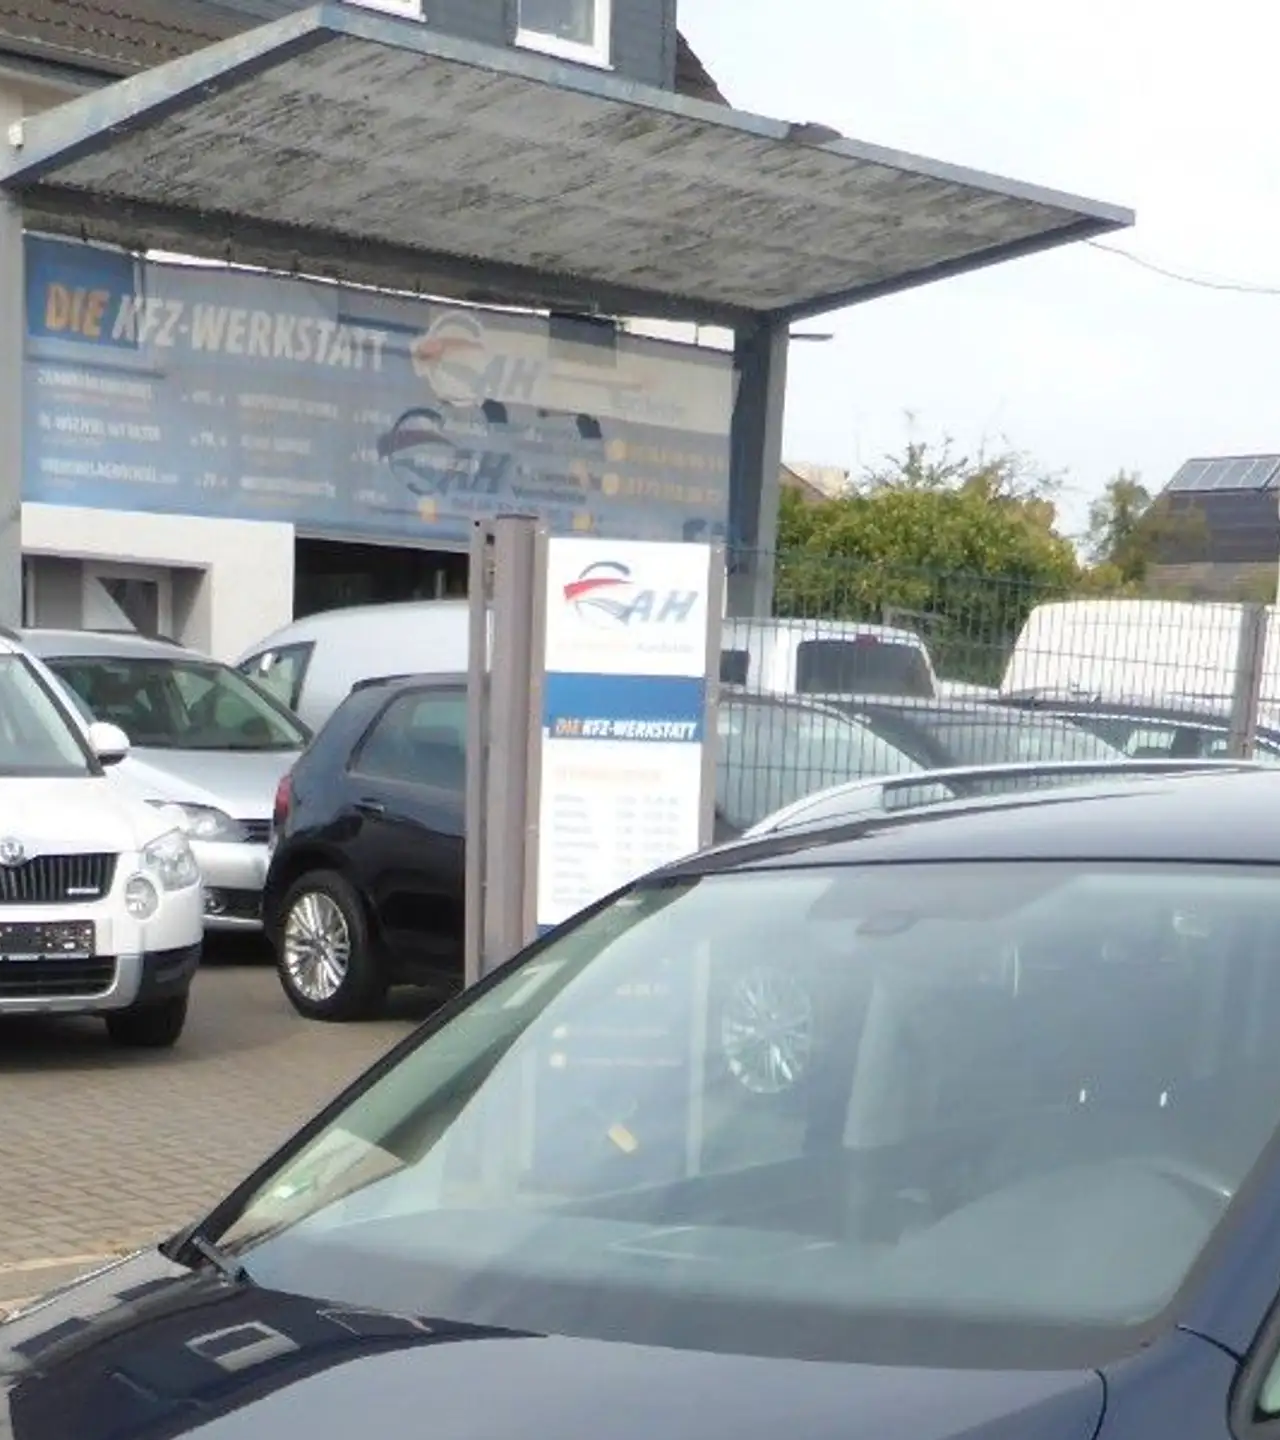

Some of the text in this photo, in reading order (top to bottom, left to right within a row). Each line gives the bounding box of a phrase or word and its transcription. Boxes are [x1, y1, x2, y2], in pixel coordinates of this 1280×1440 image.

[45, 284, 391, 373] DIE KFZ-WERKSTATT
[625, 589, 698, 624] AH
